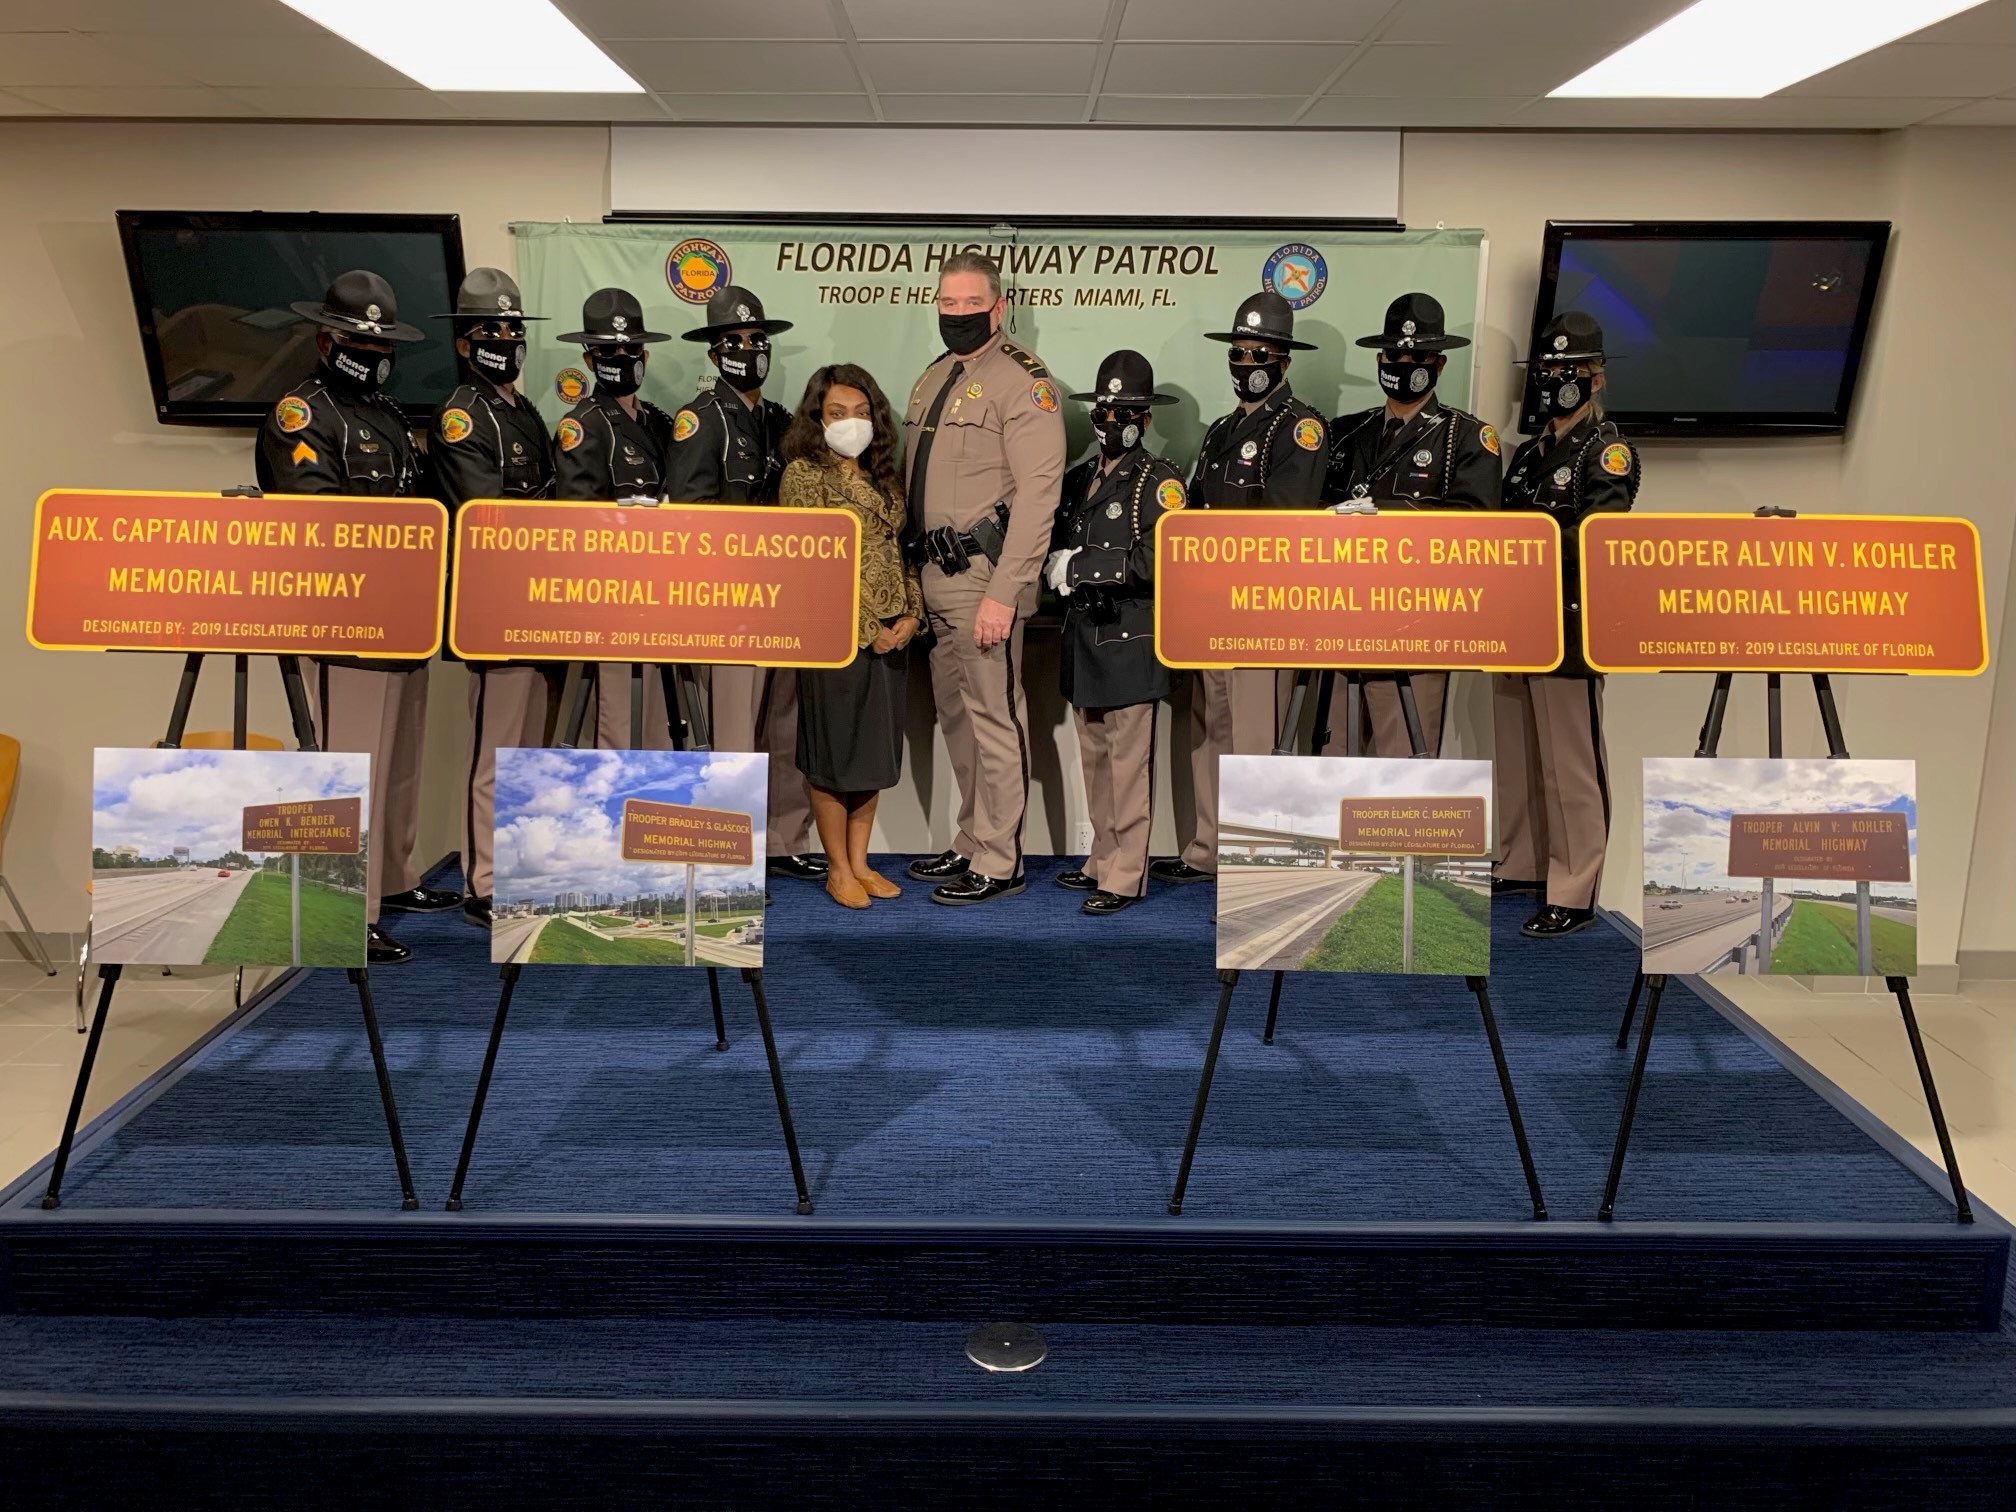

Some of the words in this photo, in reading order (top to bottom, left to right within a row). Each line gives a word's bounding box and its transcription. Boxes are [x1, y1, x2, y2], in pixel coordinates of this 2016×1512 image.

[672, 243, 725, 264] HIGHWAY
[776, 242, 913, 273] FLORIDA
[1093, 245, 1219, 275] PATROL
[1270, 245, 1319, 264] FLORIDA
[675, 282, 721, 300] PATROL
[818, 286, 885, 304] TROOP
[889, 287, 902, 304] E
[1073, 288, 1145, 310] MIAMI,
[1151, 289, 1177, 306] FL.
[1300, 277, 1326, 307] PATROL
[338, 352, 370, 374] Honor
[476, 355, 506, 371] Guard
[477, 347, 508, 362] Honor
[721, 356, 747, 369] Honor
[335, 359, 367, 382] Guard
[596, 362, 621, 374] Honor
[721, 363, 747, 377] Guard
[1380, 369, 1400, 383] Honor
[48, 516, 104, 542] AUX.
[112, 517, 218, 544] CAPTAIN
[227, 519, 296, 546] OWEN
[305, 522, 326, 547] K.
[334, 523, 435, 550] BENDER
[468, 526, 577, 552] TROOPER
[583, 529, 691, 555] BRADLEY
[697, 532, 717, 556] S.
[724, 533, 848, 559] GLASCOCK
[1168, 536, 1291, 563] TROOPER
[1300, 537, 1388, 564] ELMER
[1397, 537, 1421, 564] C.
[1429, 538, 1547, 565] BARNETT
[1604, 540, 1729, 566] TROOPER
[1737, 540, 1814, 567] ALVIN
[1821, 541, 1845, 568] V.
[1853, 542, 1957, 570] KOHLER
[108, 567, 243, 595] MEMORIAL
[251, 570, 366, 598] HIGHWAY
[528, 577, 660, 605] MEMORIAL
[668, 581, 782, 608] HIGHWAY
[1231, 586, 1362, 611] MEMORIAL
[1370, 587, 1484, 612] HIGHWAY
[1658, 589, 1791, 614] MEMORIAL
[1798, 590, 1909, 616] HIGHWAY
[83, 619, 161, 634] DESIGNATED
[165, 621, 185, 635] BY:
[191, 622, 222, 635] 2019
[225, 623, 308, 638] LEGISLATURE
[312, 625, 328, 638] OF
[331, 625, 385, 640] FLORIDA
[504, 629, 581, 644] DESIGNATED
[585, 631, 605, 645] BY:
[610, 632, 640, 645] 2019
[643, 633, 726, 648] LEGISLATURE
[729, 635, 746, 648] OF
[749, 635, 801, 649] FLORIDA
[1209, 637, 1286, 650] DESIGNATED
[1289, 638, 1309, 651] BY:
[1314, 638, 1344, 651] 2019
[1347, 638, 1430, 653] LEGISLATURE
[1434, 640, 1450, 653] OF
[1454, 640, 1507, 653] FLORIDA
[1639, 641, 1716, 654] DESIGNATED
[1719, 642, 1740, 655] BY:
[1745, 642, 1775, 655] 2019
[1778, 642, 1861, 656] LEGISLATURE
[1863, 643, 1880, 656] OF
[1883, 643, 1935, 657] FLORIDA
[278, 804, 314, 815] TROOPER
[1352, 810, 1390, 819] TROOPER
[1391, 810, 1420, 819] ELMER
[1432, 810, 1472, 819] BARNETT
[259, 818, 280, 828] OWEN
[300, 815, 335, 826] BENDER
[627, 812, 667, 826] TROOPER
[669, 817, 705, 829] BRADLEY
[714, 822, 750, 834] GLASCOCK
[1743, 821, 1783, 834] TROOPER
[1792, 820, 1820, 833] ALVIN
[1852, 820, 1893, 833] KOHLER
[247, 828, 284, 839] MEMORIAL
[290, 826, 352, 838] INTERCHANGE
[643, 834, 695, 847] MEMORIAL
[698, 838, 738, 850] HIGHWAY
[1358, 827, 1411, 837] MEMORIAL
[1414, 828, 1464, 838] HIGHWAY
[1762, 838, 1811, 851] MEMORIAL
[1821, 838, 1868, 851] HIGHWAY
